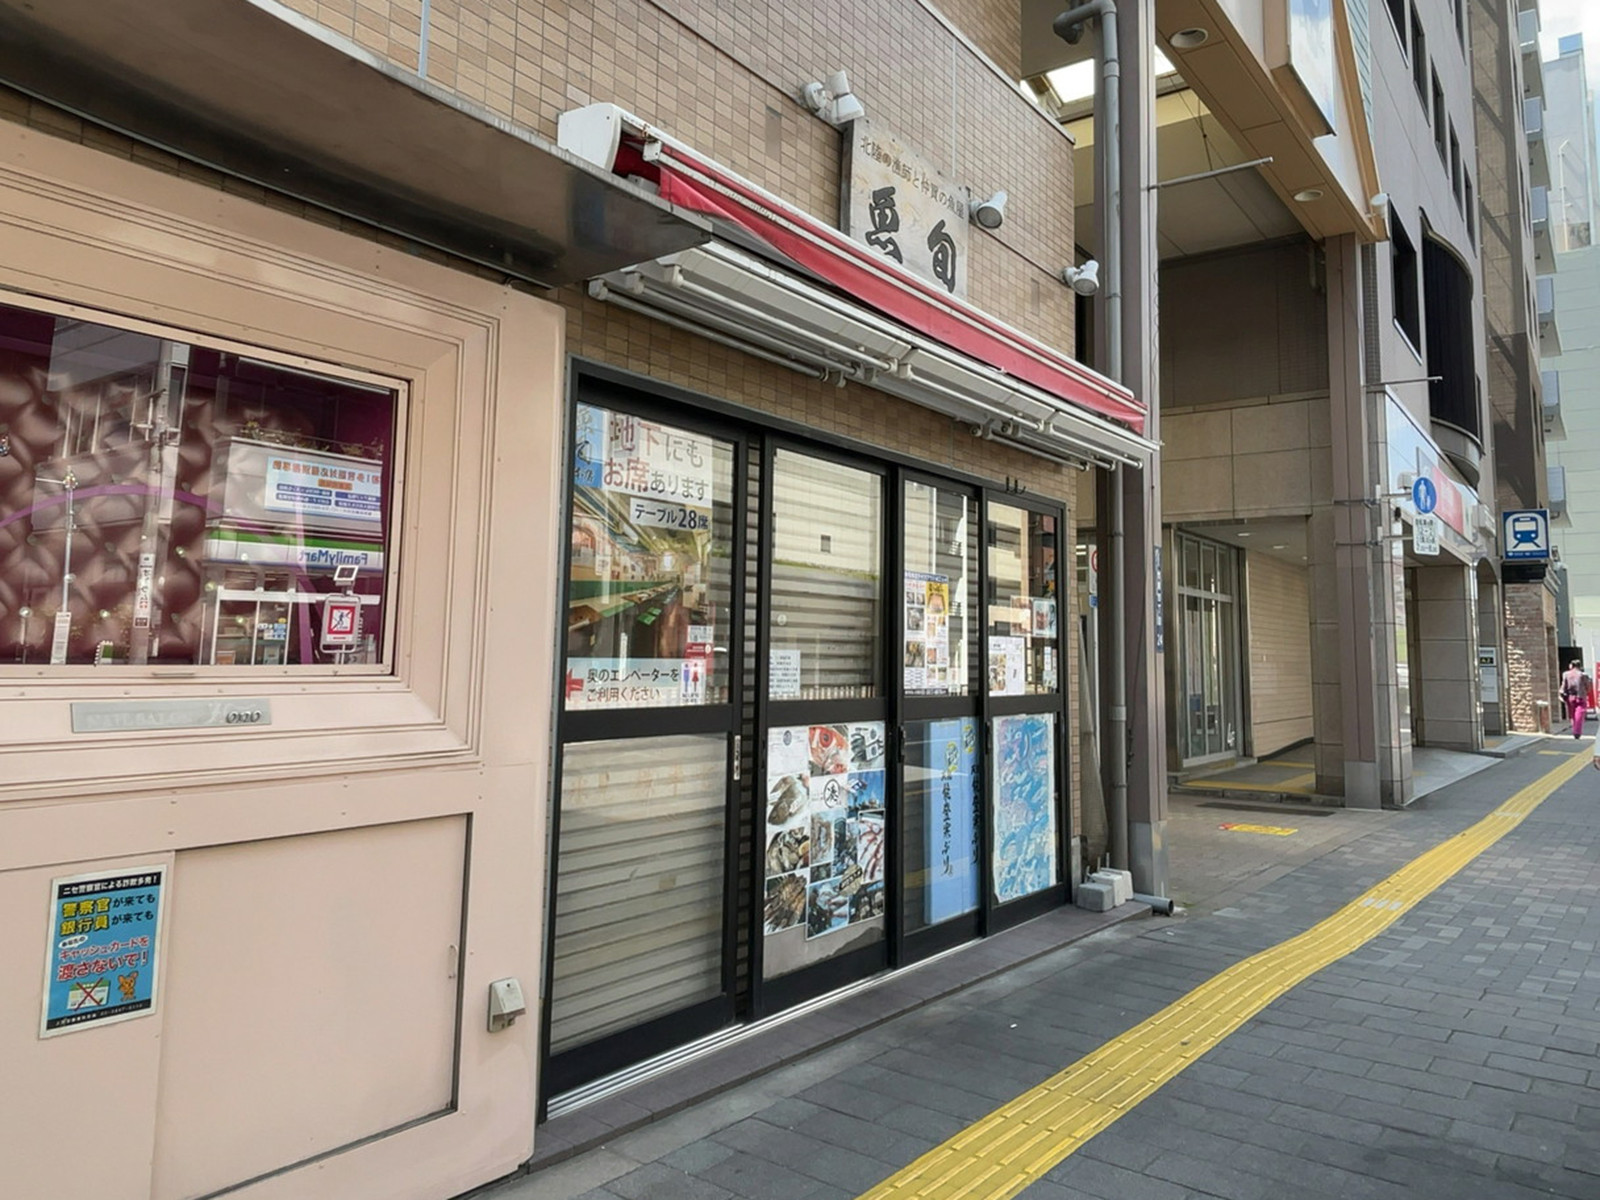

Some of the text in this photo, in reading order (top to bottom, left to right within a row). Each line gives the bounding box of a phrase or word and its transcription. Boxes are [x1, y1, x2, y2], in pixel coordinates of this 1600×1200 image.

[608, 412, 704, 468] 地下にも
[603, 457, 709, 501] お席あります
[635, 503, 709, 530] テーブル28席
[586, 686, 661, 703] ご利用ください
[62, 893, 156, 918] 警察官が来ても
[60, 910, 154, 936] 銀行員が来ても
[60, 936, 149, 961] キャッシュカードを
[58, 951, 149, 981] 渡さないで！
